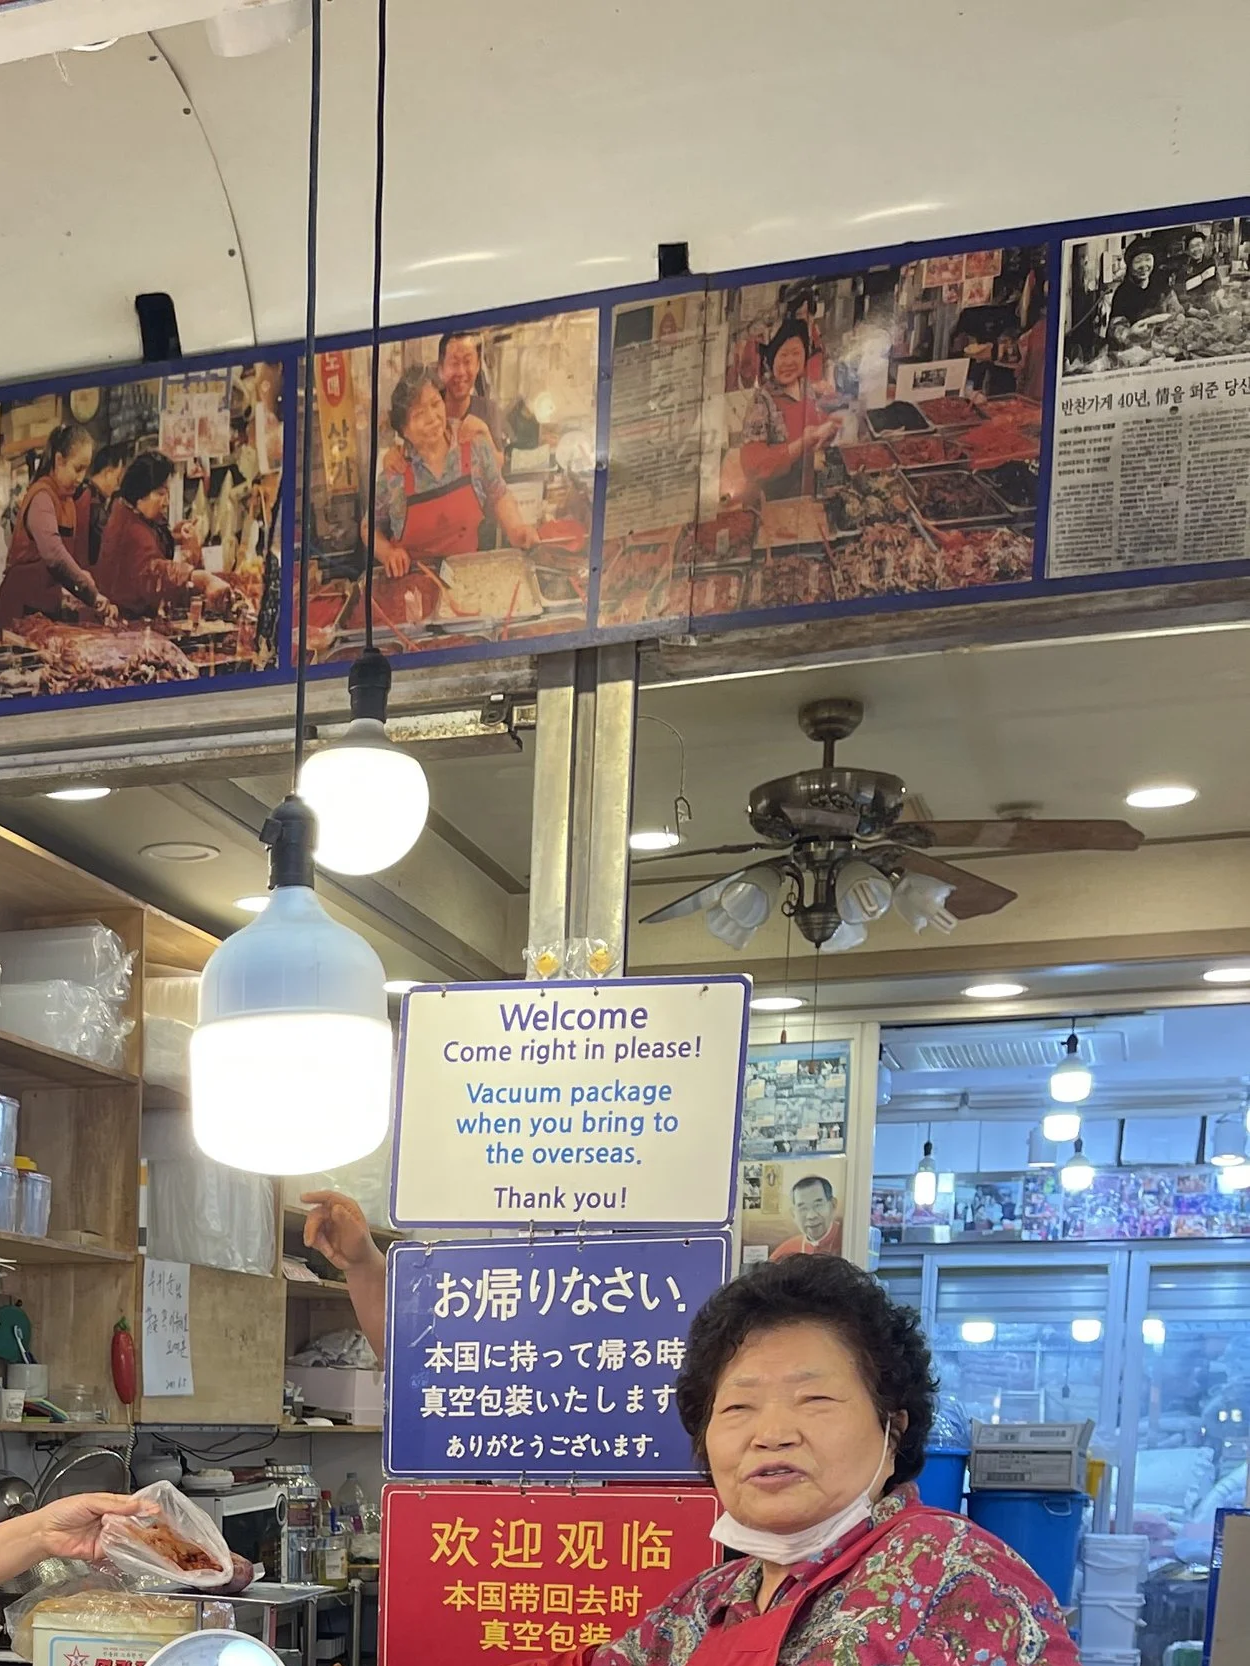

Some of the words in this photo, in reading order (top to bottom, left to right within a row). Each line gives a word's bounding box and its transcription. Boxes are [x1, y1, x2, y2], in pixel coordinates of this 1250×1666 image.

[1061, 393, 1114, 417] 반찬가게
[1117, 389, 1151, 412] 40년,
[500, 1001, 648, 1032] Welcome
[443, 1042, 512, 1063] Come
[521, 1039, 577, 1065] right
[584, 1037, 604, 1060] in
[614, 1036, 701, 1063] please!
[466, 1083, 561, 1104] Vacuum
[570, 1080, 672, 1107] package
[456, 1112, 521, 1134] when
[529, 1117, 572, 1138] you
[582, 1110, 645, 1137] bring
[653, 1112, 679, 1133] to
[485, 1141, 524, 1164] the
[532, 1146, 642, 1165] overseas.
[493, 1186, 566, 1209] Thank
[573, 1187, 627, 1213] you!
[423, 1336, 686, 1374] 本国に持って帰る時
[419, 1384, 676, 1418] 真空包装いたします
[429, 1516, 673, 1572] 欢迎观临
[442, 1579, 643, 1617] 本国带回去时
